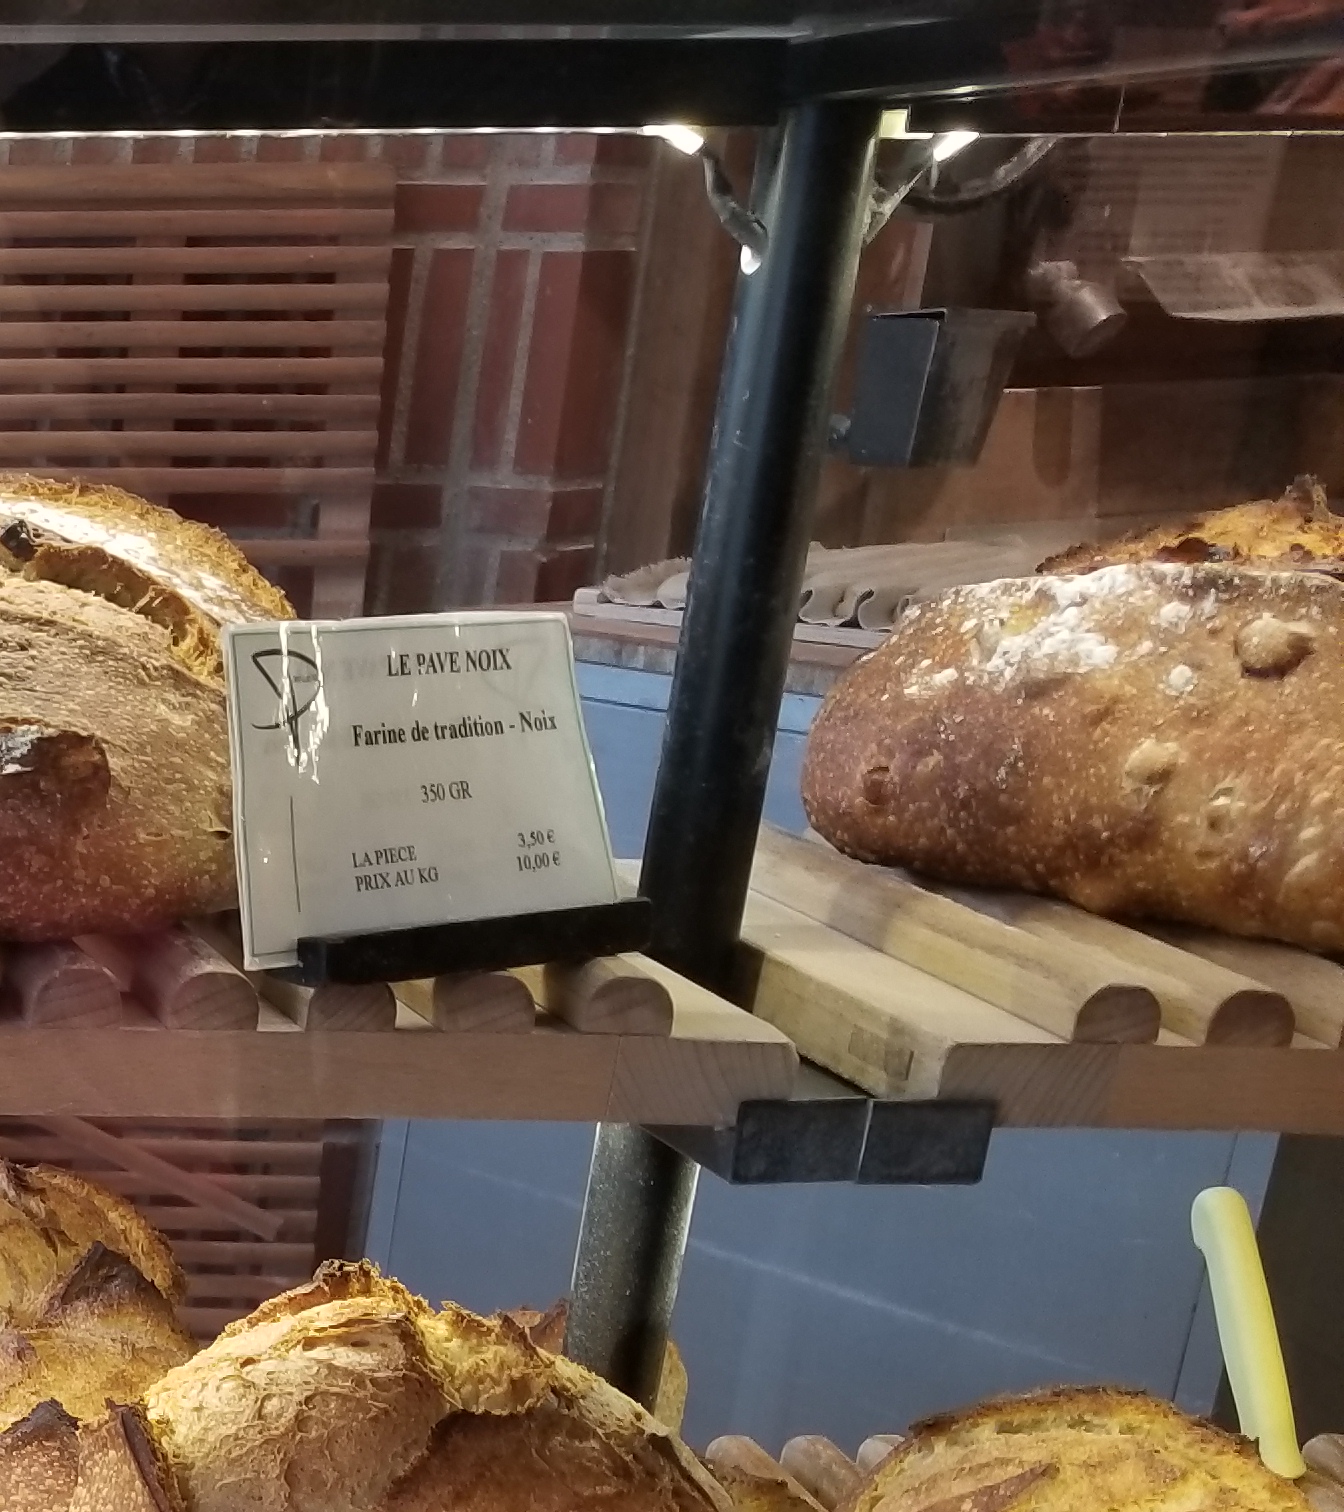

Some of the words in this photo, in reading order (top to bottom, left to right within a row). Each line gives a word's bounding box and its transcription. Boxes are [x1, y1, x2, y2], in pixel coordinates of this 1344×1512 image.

[387, 654, 411, 676] LE
[417, 651, 461, 675] PAVE
[465, 648, 512, 672] NOIX
[352, 722, 407, 746] Farine
[412, 720, 429, 742] de
[434, 715, 504, 741] tradition
[519, 709, 557, 733] Noix
[420, 783, 446, 803] 350
[449, 780, 472, 800] GR
[352, 852, 373, 868] LA
[375, 845, 417, 865] PIECE
[517, 830, 545, 849] 3,50
[547, 829, 556, 843] €
[355, 872, 391, 892] PRIX
[395, 869, 415, 888] AU
[417, 866, 439, 884] KG
[517, 852, 550, 873] 10,00
[552, 851, 561, 866] €
